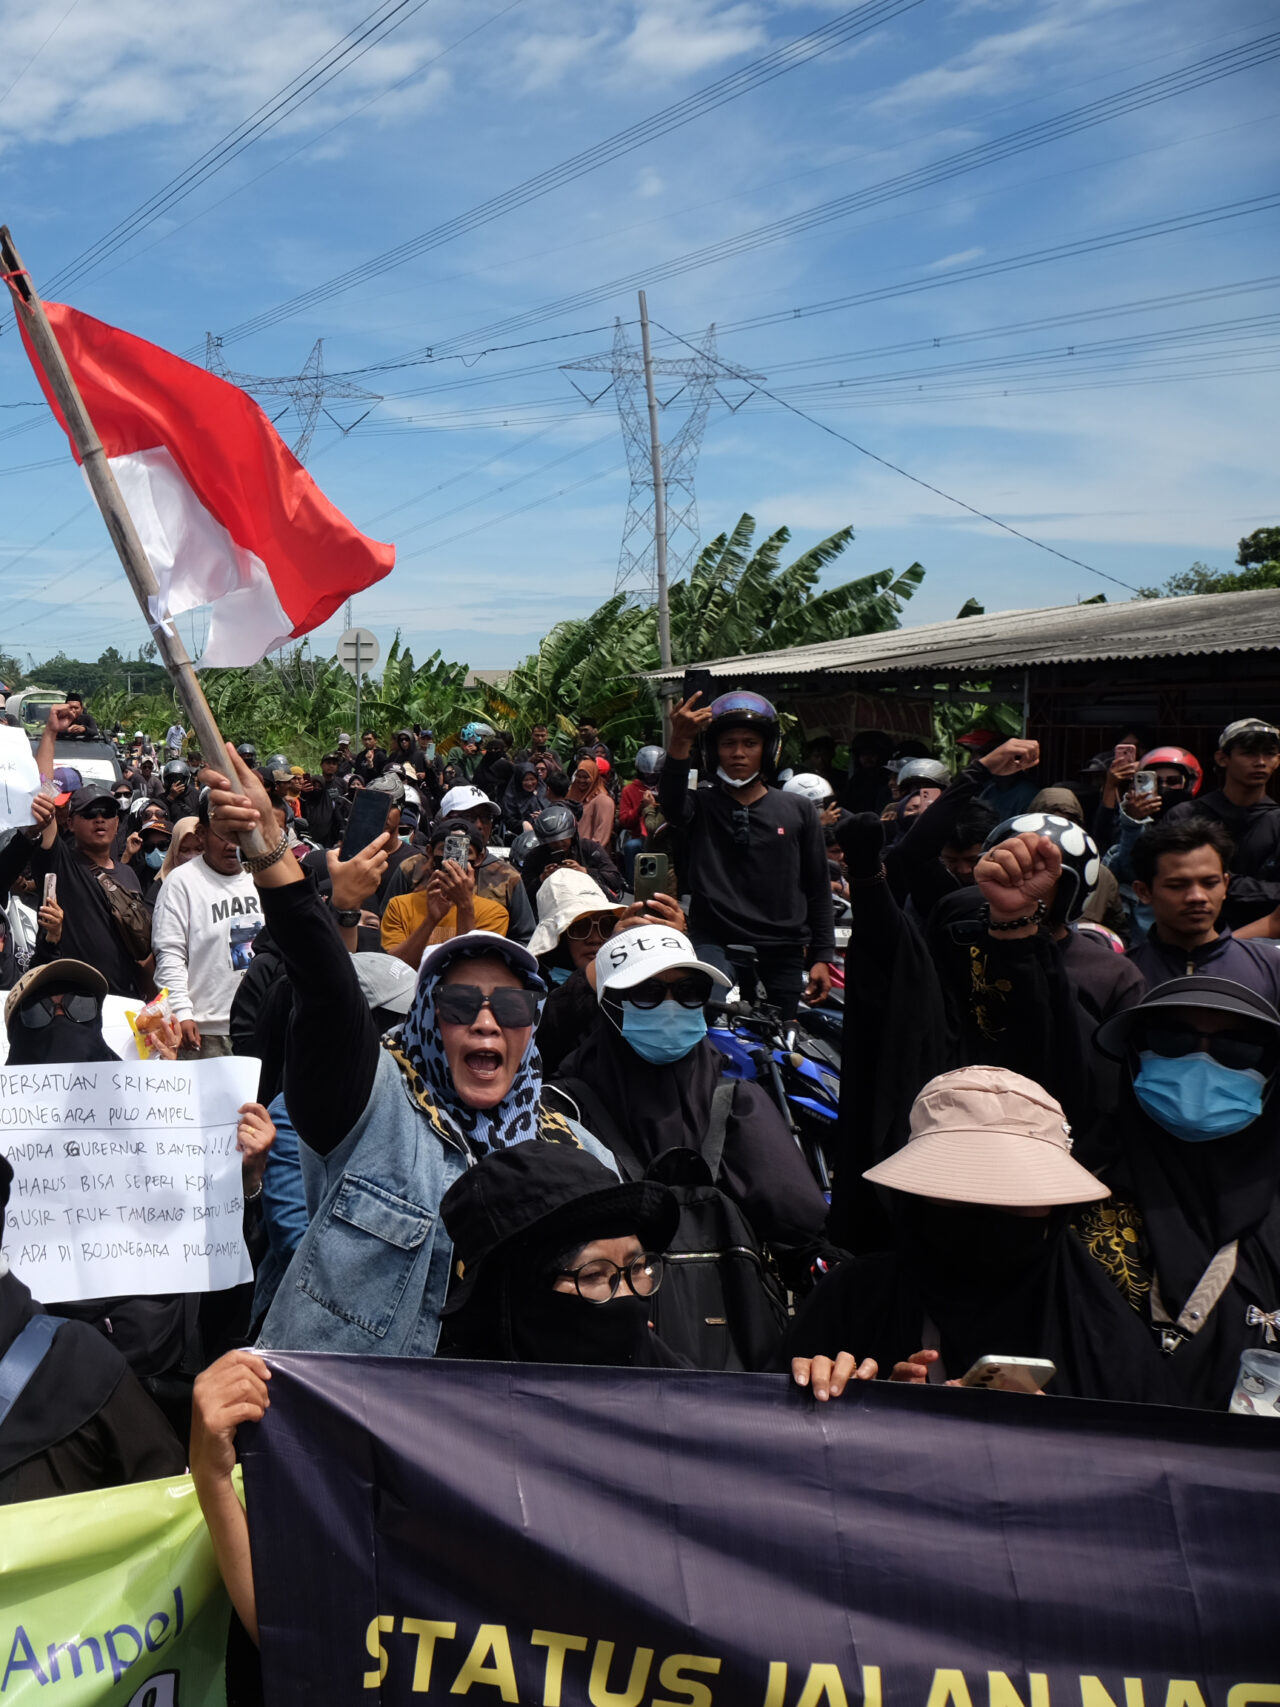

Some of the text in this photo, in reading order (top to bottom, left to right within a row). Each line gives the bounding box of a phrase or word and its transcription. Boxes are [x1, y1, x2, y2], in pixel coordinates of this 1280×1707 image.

[211, 895, 264, 924] MAR
[0, 1073, 192, 1098] PERSATUAN SRIKANDI
[108, 1108, 140, 1125] PULO
[146, 1107, 195, 1122] AMPEL
[5, 1142, 54, 1163] ANDRA
[18, 1177, 67, 1198] HARUS
[80, 1173, 115, 1193] BISA
[63, 1206, 111, 1224] TRUK
[119, 1205, 186, 1223] TAMBANG
[193, 1205, 220, 1222] BATU
[19, 1243, 48, 1266] ADA
[57, 1243, 72, 1263] DI
[81, 1240, 170, 1263] BOJONEGARA
[363, 1614, 722, 1707] STATUS
